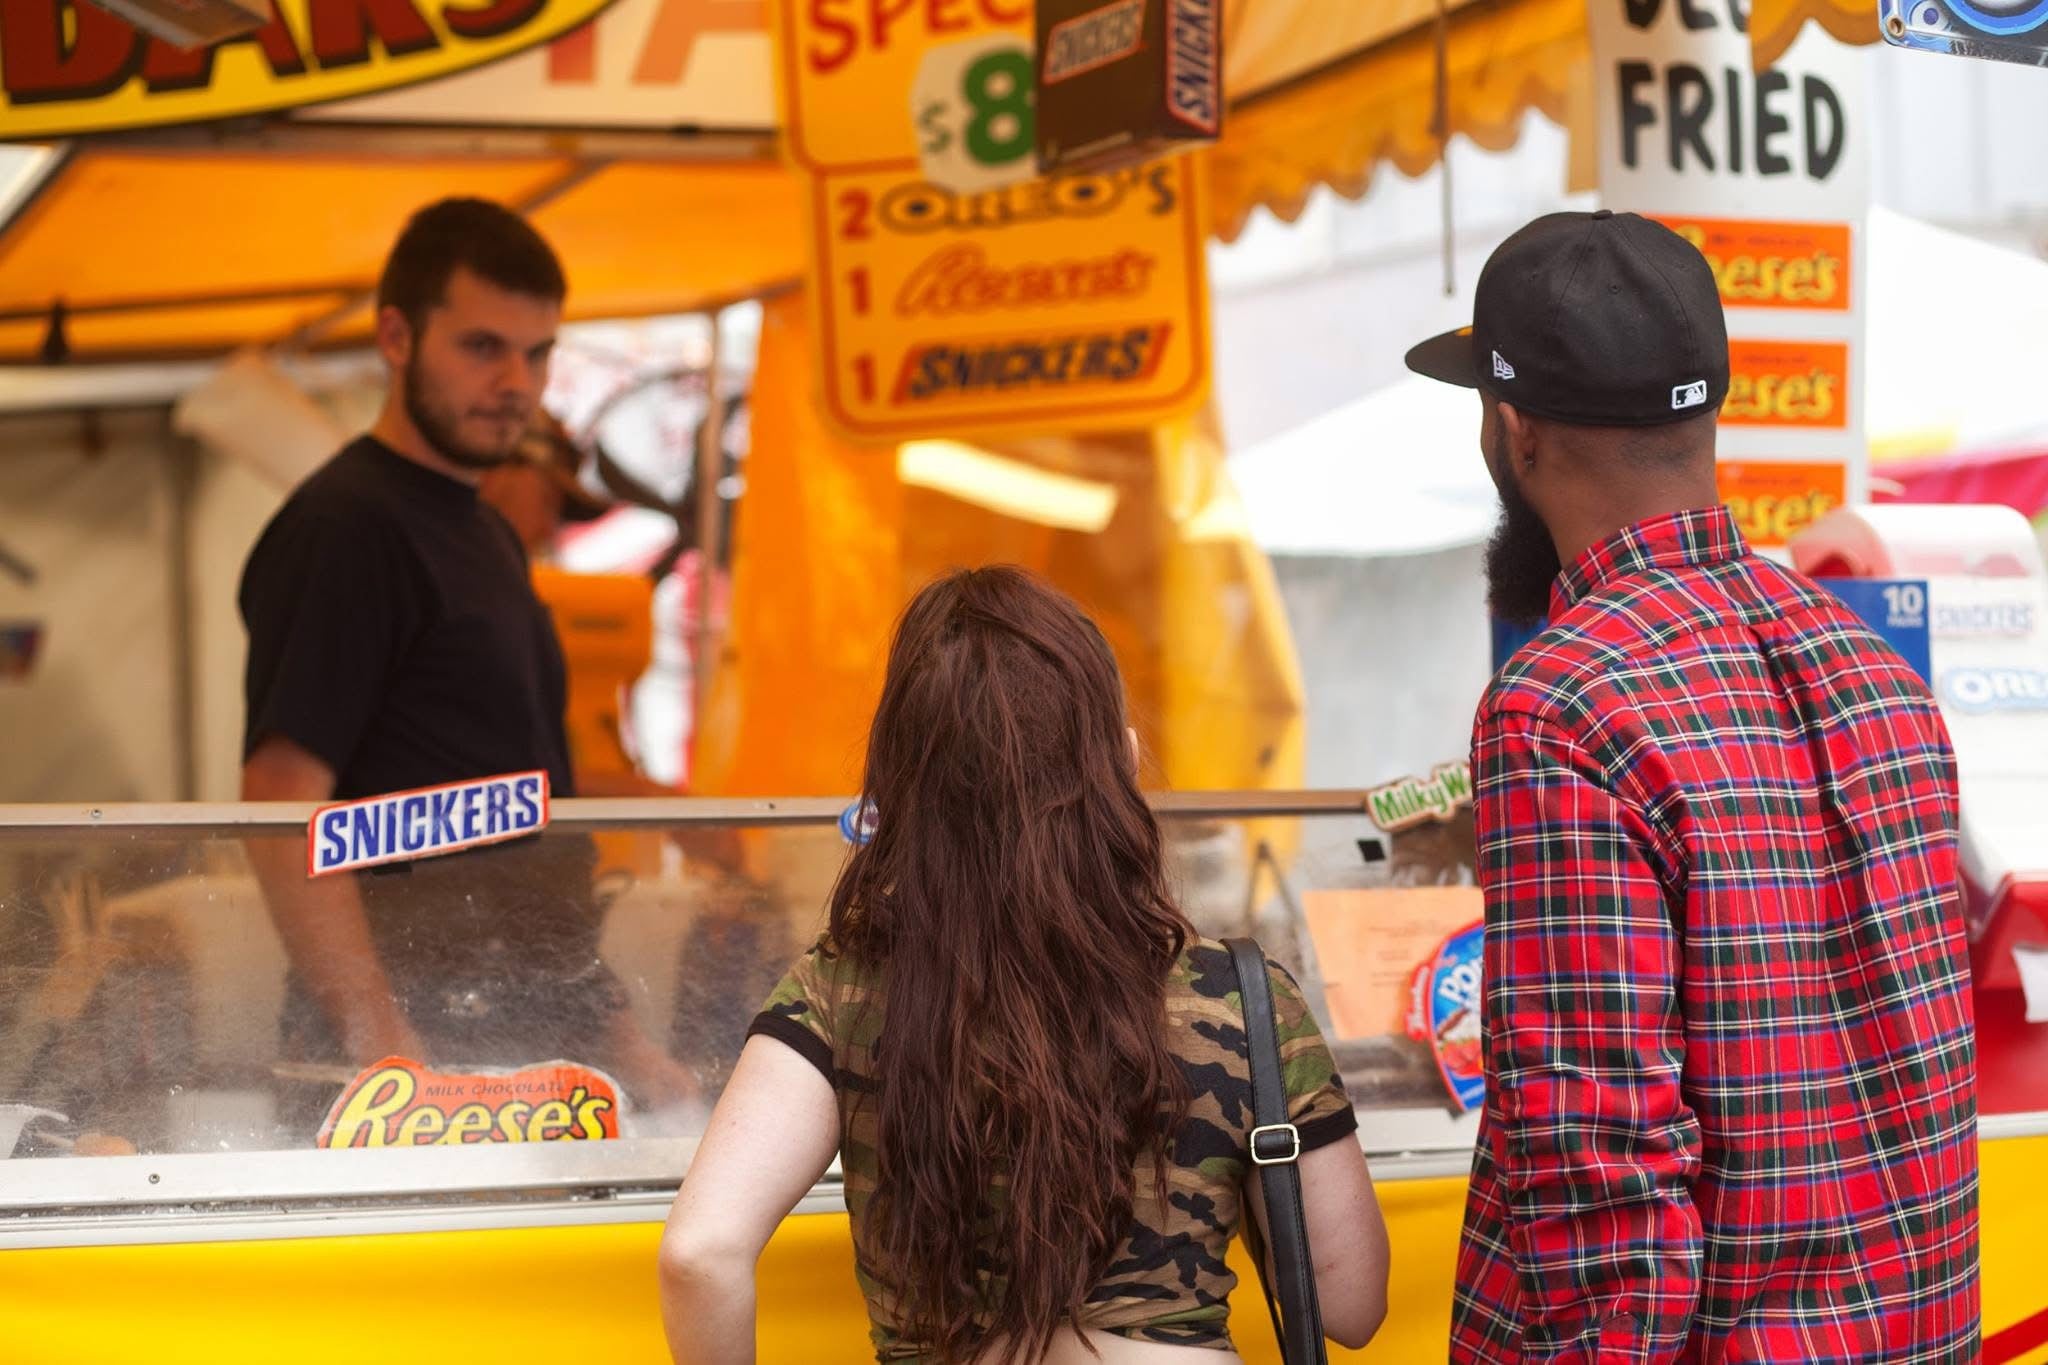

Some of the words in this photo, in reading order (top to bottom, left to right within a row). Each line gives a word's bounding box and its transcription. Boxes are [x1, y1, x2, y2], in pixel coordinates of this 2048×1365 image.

[1616, 60, 1845, 180] FRIED
[839, 188, 873, 240] 2
[847, 267, 870, 316] 1
[852, 354, 877, 402] 1
[910, 329, 1151, 398] SNICKERS
[1883, 584, 1924, 614] 10
[321, 777, 539, 868] SNICKERS
[329, 1066, 613, 1148] Reese's
[424, 1084, 466, 1097] MILK
[471, 1080, 566, 1096] CHOCOLATE
